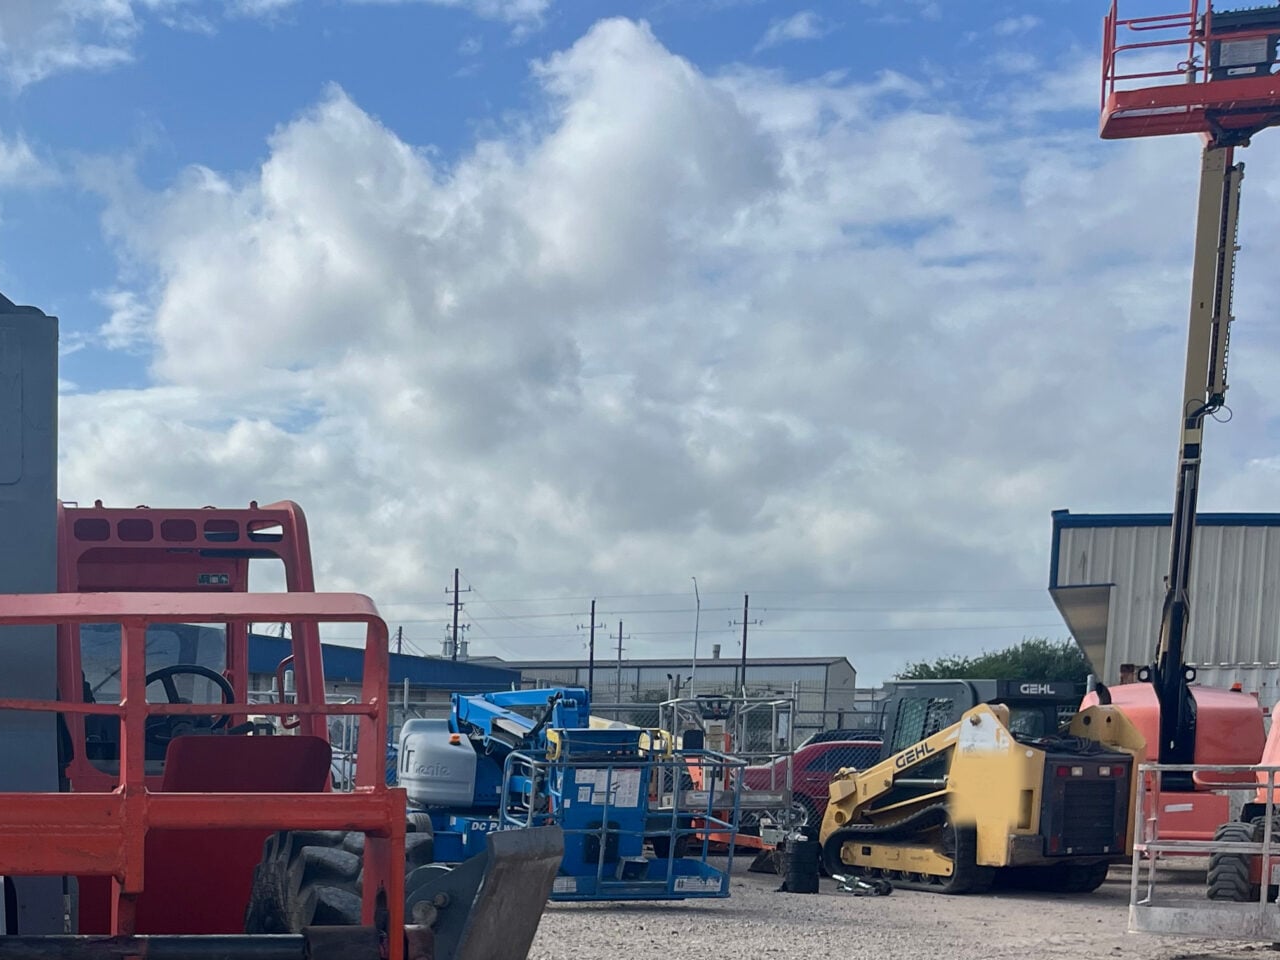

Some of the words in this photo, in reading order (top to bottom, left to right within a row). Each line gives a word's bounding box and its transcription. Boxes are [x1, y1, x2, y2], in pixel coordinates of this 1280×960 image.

[1020, 683, 1056, 695] GEHL
[895, 742, 936, 769] GEHL
[471, 821, 487, 831] DC
